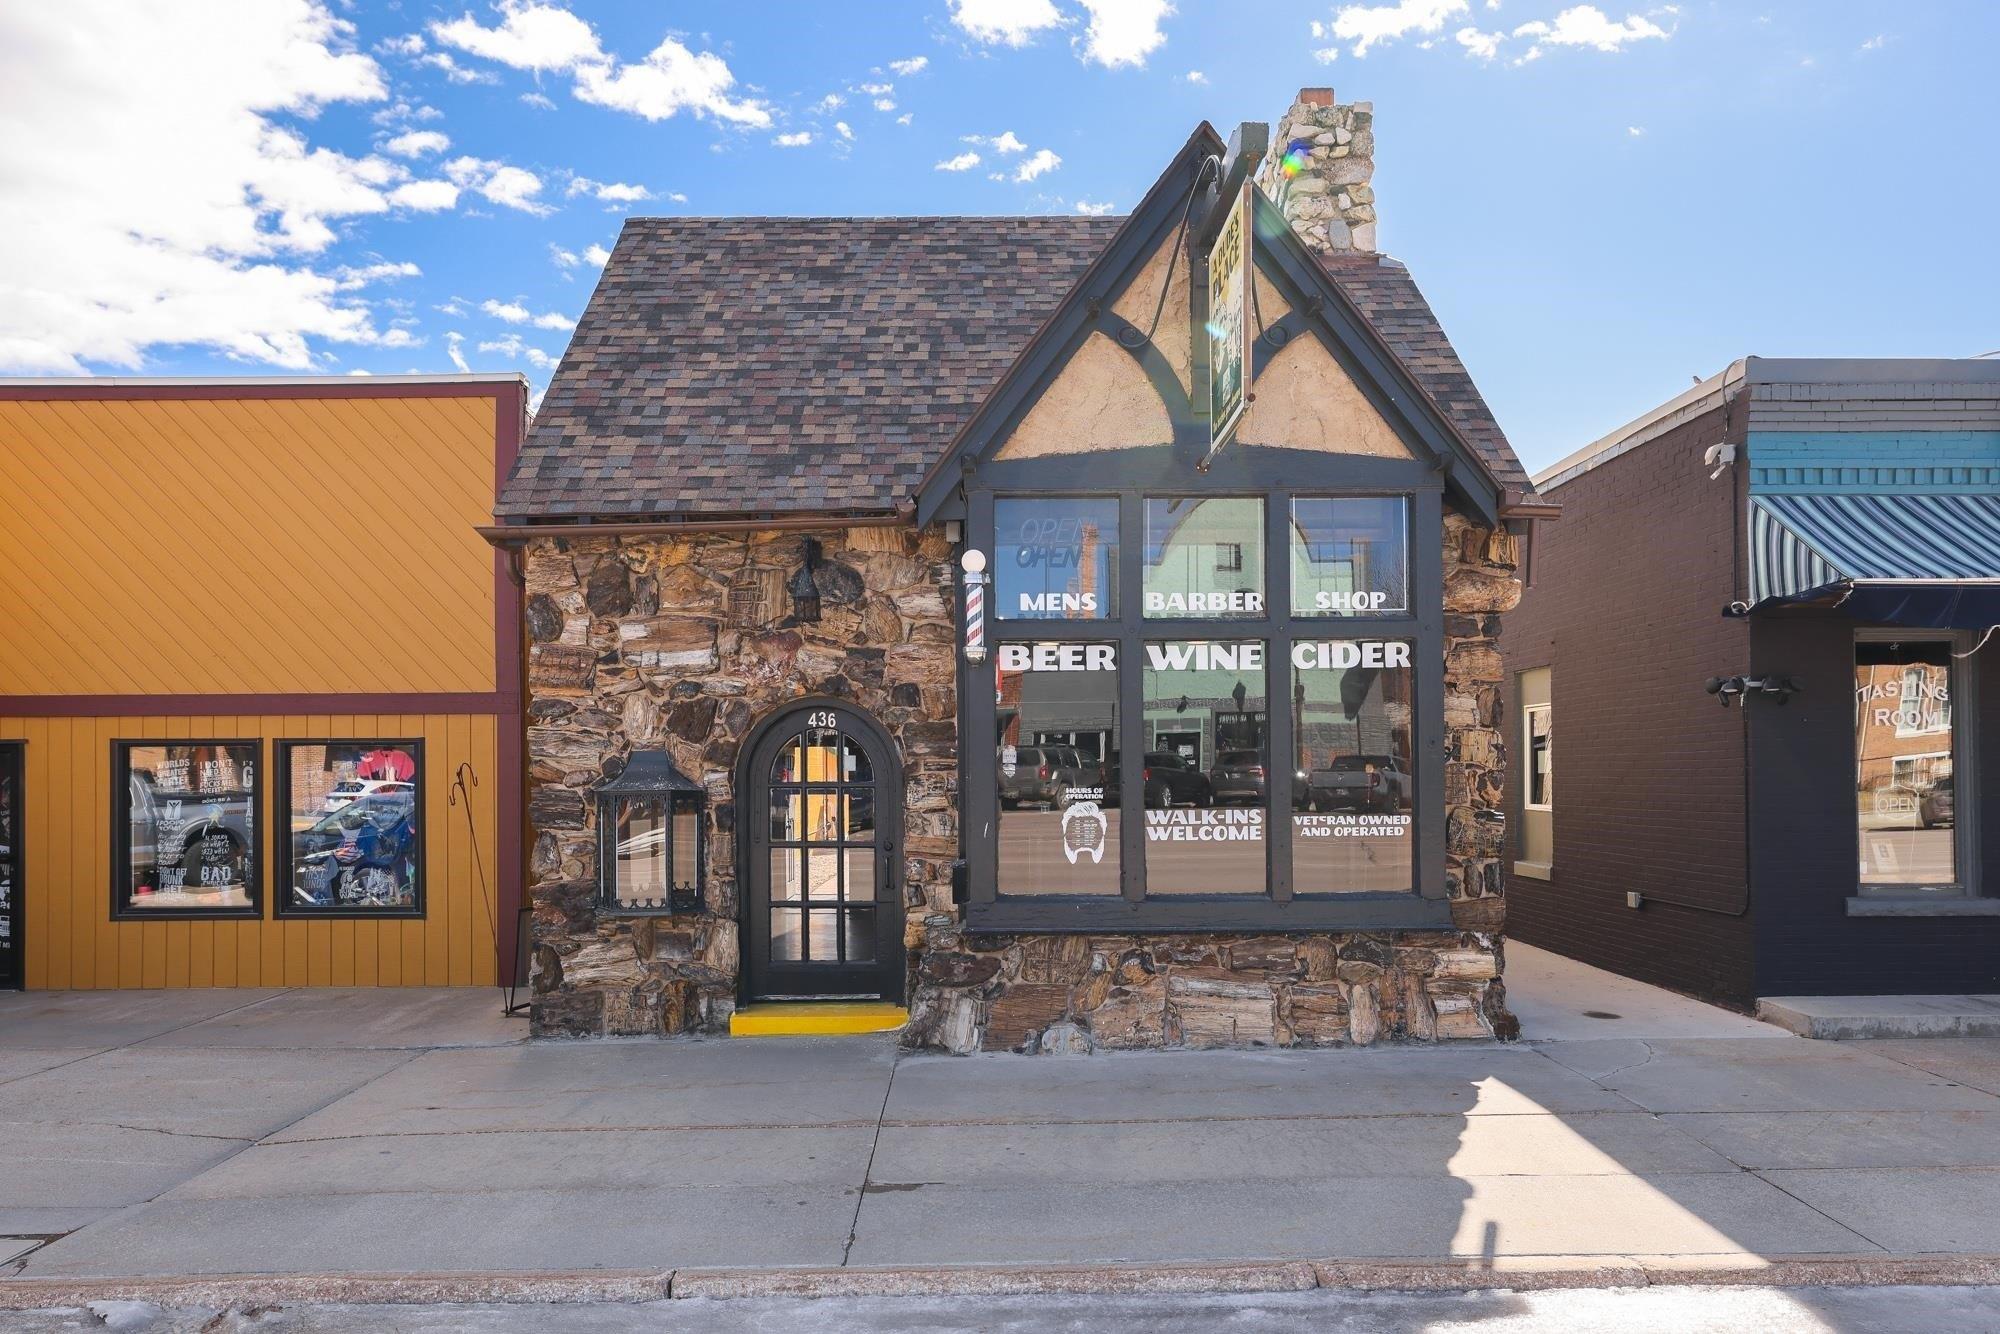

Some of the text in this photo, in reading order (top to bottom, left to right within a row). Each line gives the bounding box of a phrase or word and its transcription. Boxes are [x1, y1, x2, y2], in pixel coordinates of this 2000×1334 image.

[1212, 234, 1240, 302] PLACE
[1020, 592, 1098, 611] MENS
[1146, 592, 1264, 611] BARBER
[1316, 591, 1387, 609] SHOP
[998, 644, 1117, 671] BEER
[1145, 644, 1262, 671] WINE
[1291, 642, 1411, 669] CIDER
[1856, 680, 1949, 703] TASTING
[807, 711, 837, 728] 436
[1874, 708, 1939, 728] ROOM
[1878, 797, 1917, 814] OPEN
[1146, 808, 1262, 825] WALK-INS
[1359, 815, 1411, 825] OWNED
[1146, 825, 1262, 841] WELCOME
[1300, 826, 1404, 837] AND OPERATED
[200, 866, 232, 881] BAD
